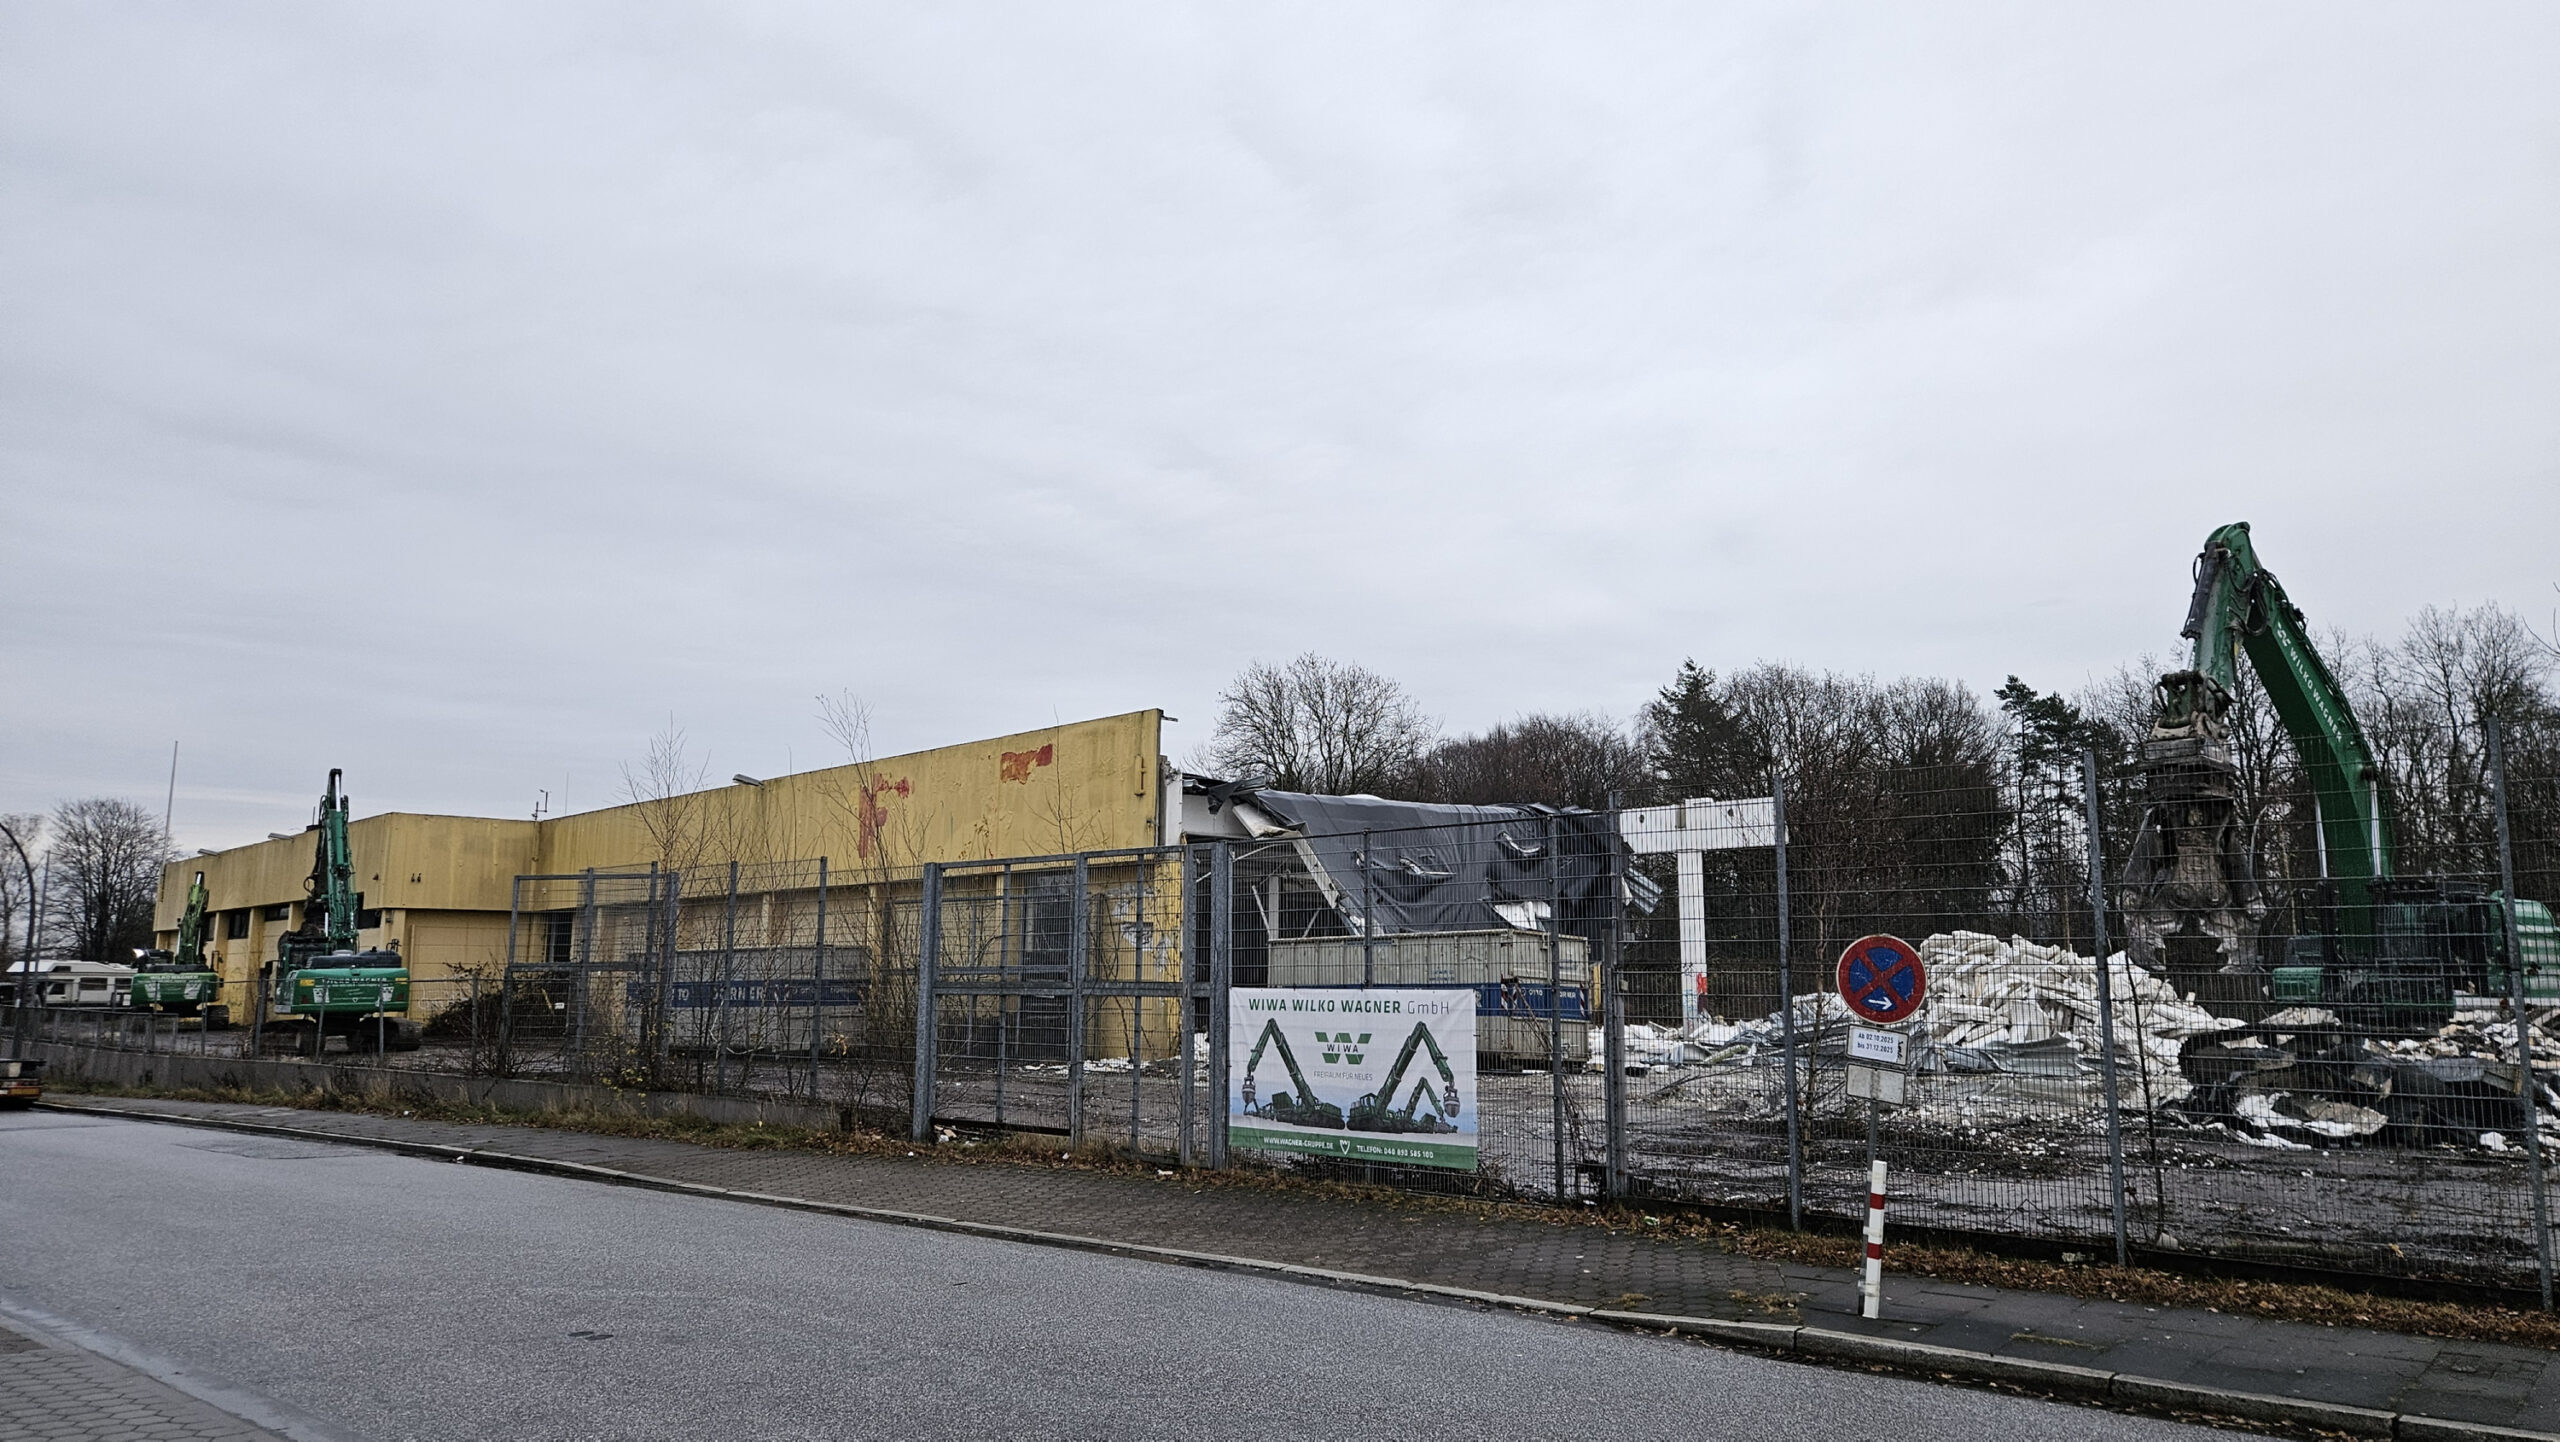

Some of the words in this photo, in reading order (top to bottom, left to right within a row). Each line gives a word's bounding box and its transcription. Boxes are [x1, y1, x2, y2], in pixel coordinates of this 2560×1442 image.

[2289, 646, 2314, 690] WILKO
[1248, 998, 1287, 1011] WIWA
[1292, 999, 1335, 1012] WILKO
[1341, 999, 1401, 1014] WAGNER
[1407, 1000, 1450, 1015] GmbH
[1326, 1043, 1359, 1053] WIWA
[1383, 1147, 1395, 1155] 040
